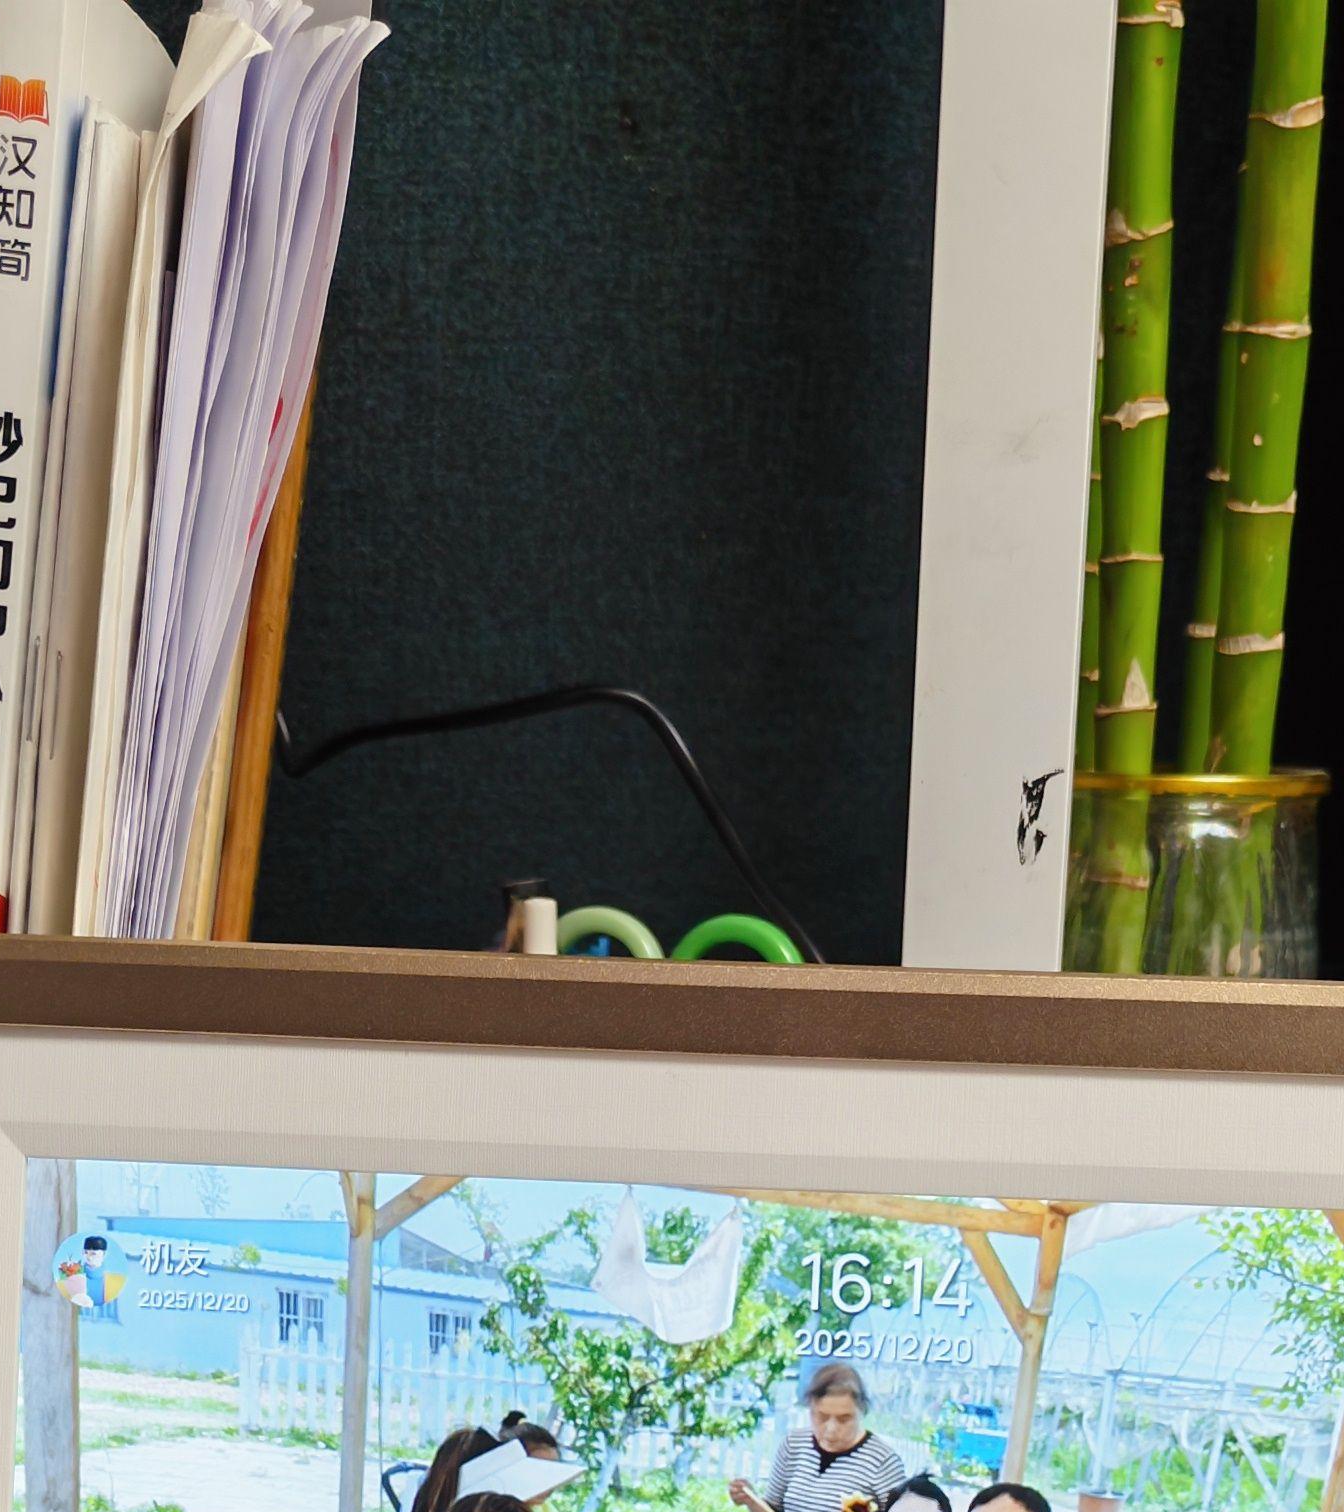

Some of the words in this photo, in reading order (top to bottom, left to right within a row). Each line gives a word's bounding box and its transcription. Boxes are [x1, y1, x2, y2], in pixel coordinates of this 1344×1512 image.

[140, 1240, 210, 1278] 机友
[137, 1289, 250, 1314] 2025/12/20
[801, 1252, 974, 1318] 16:14
[794, 1329, 974, 1363] 2025/12/20
